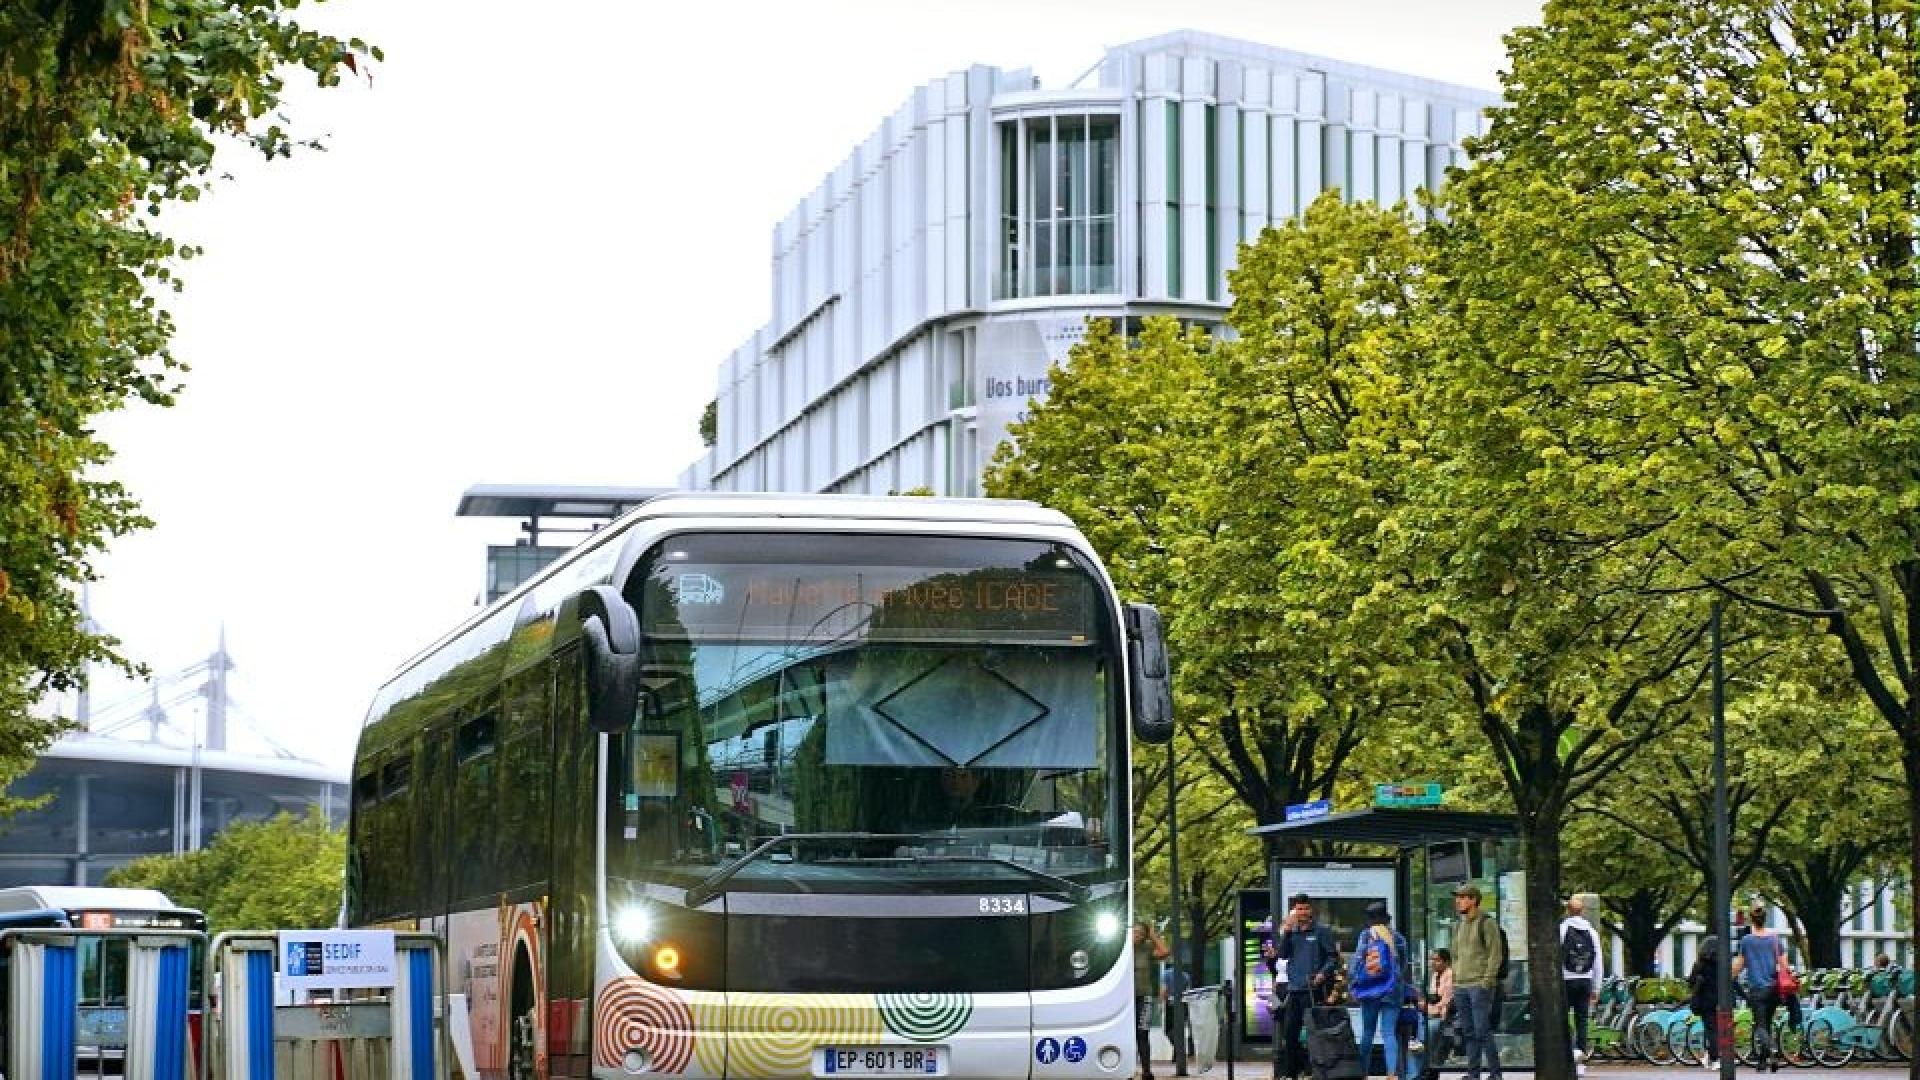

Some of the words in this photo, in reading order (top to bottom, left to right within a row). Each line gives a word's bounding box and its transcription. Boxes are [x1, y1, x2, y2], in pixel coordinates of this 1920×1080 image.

[976, 582, 1059, 611] ICADE
[979, 897, 1025, 913] 8334
[325, 943, 361, 959] SEDIF
[837, 1051, 923, 1069] EP-601-BR
